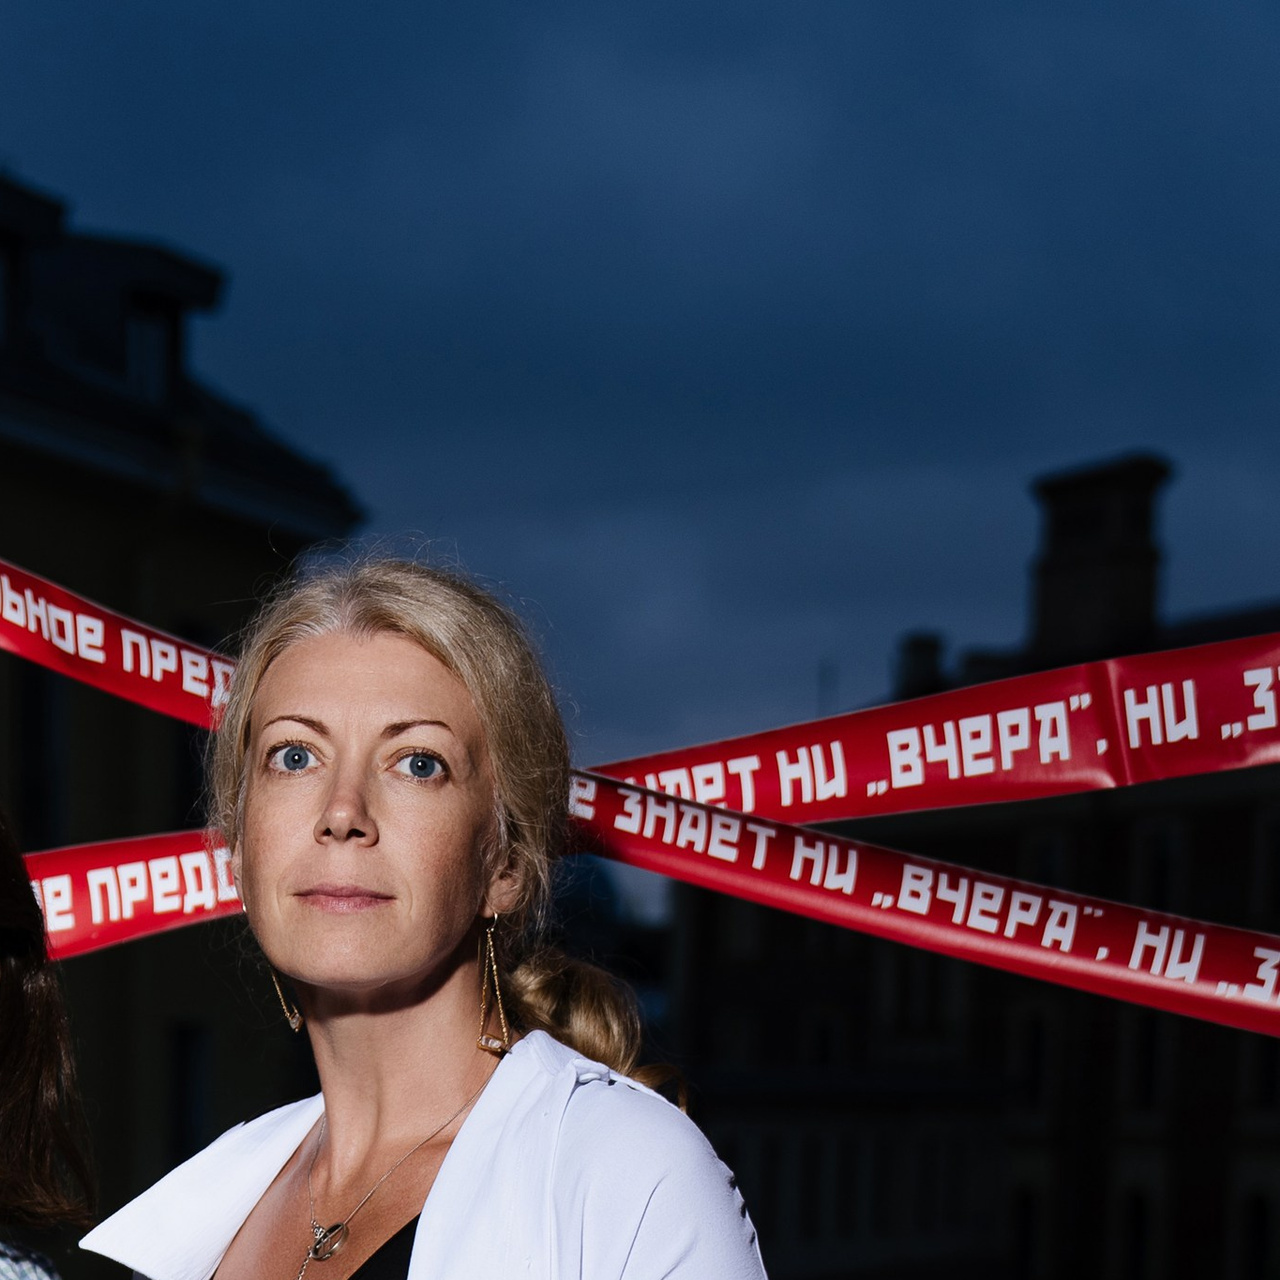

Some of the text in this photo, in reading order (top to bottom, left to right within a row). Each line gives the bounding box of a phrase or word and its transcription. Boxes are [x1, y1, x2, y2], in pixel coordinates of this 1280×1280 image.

[775, 740, 847, 807] НИ
[1124, 678, 1199, 749] НИ
[613, 786, 776, 870] ЗНАЕТ
[789, 835, 859, 897] НИ
[1128, 920, 1206, 984] НИ
